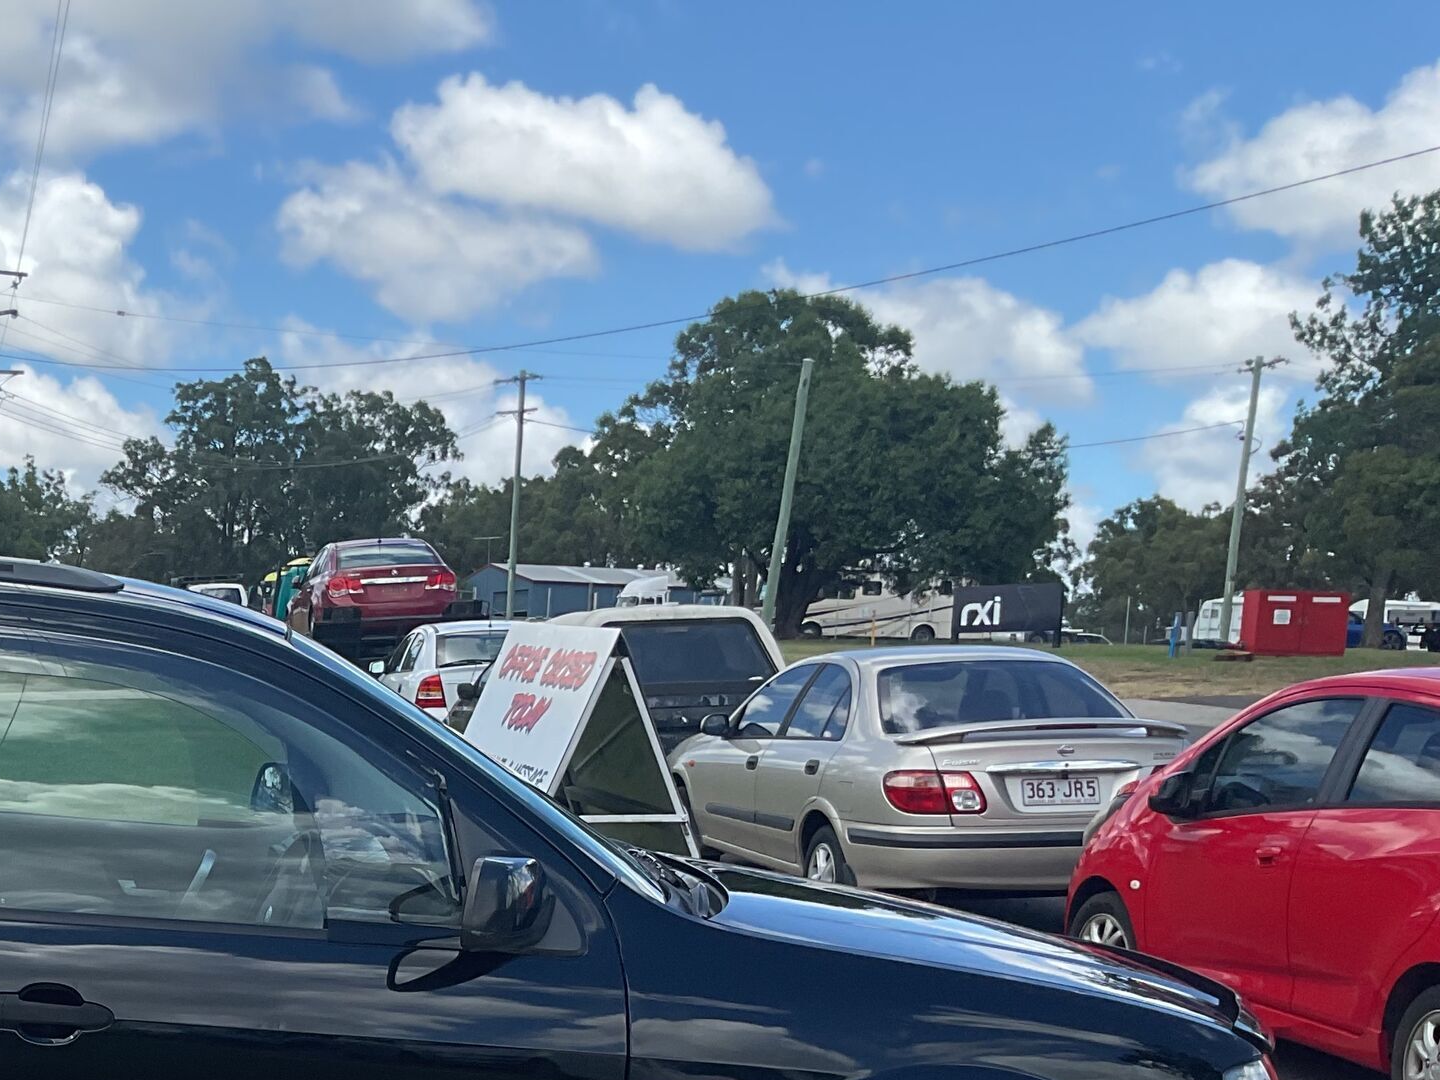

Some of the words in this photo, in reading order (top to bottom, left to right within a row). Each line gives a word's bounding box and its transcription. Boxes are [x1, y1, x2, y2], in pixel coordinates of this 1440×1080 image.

[499, 643, 551, 684] OFFICE
[540, 648, 597, 692] CLOSED
[501, 692, 552, 735] TODAY
[1026, 781, 1056, 799] 363
[1063, 779, 1097, 798] JR5
